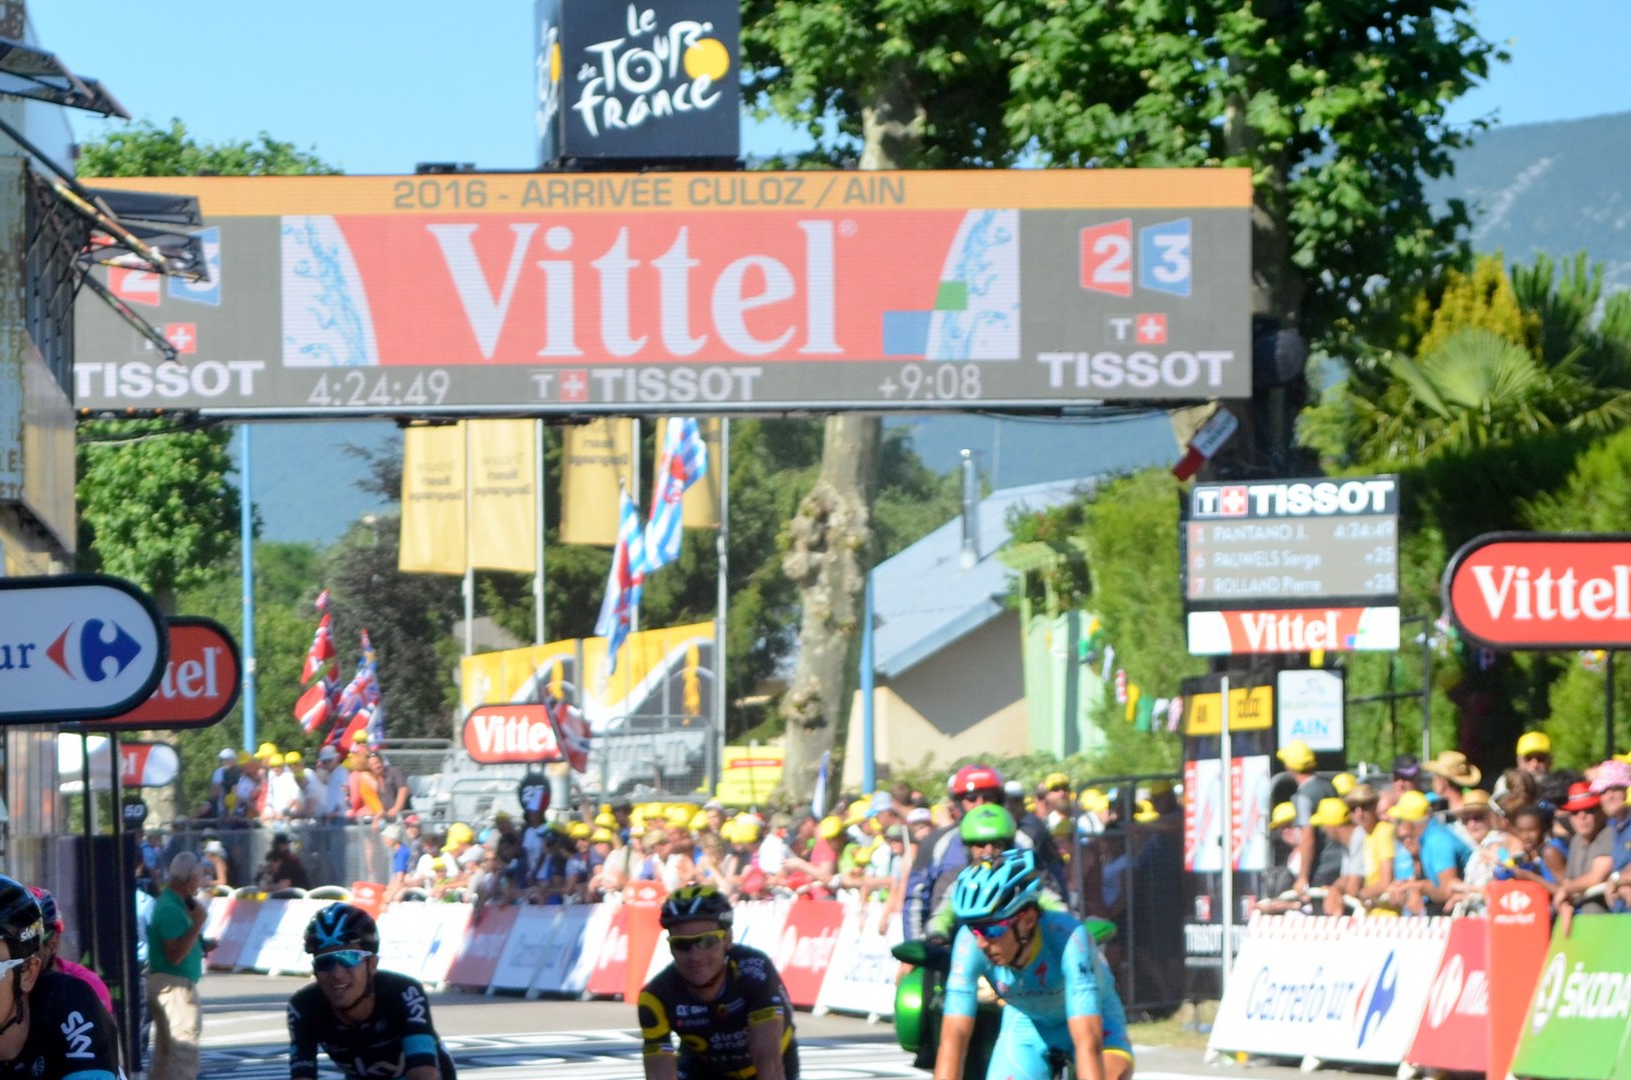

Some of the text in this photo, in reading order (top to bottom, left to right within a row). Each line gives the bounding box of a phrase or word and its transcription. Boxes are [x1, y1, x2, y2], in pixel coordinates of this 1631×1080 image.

[626, 3, 657, 36] Le
[393, 181, 487, 209] 2016
[521, 173, 672, 207] ARRIVÉE
[688, 176, 805, 206] CULOZ
[844, 176, 906, 204] AIN
[425, 218, 845, 358] Vittel
[73, 361, 265, 398] TISSOT
[588, 366, 762, 402] TISSOT
[878, 365, 982, 401] +9:08
[1037, 351, 1235, 388] TISSOT
[307, 371, 451, 406] 4:24:49
[1249, 480, 1395, 515] TISSOT
[1470, 565, 1631, 620] Vittel
[1239, 612, 1339, 650] Vittel
[1290, 718, 1328, 736] AIN
[1244, 965, 1357, 1023] Carrefour
